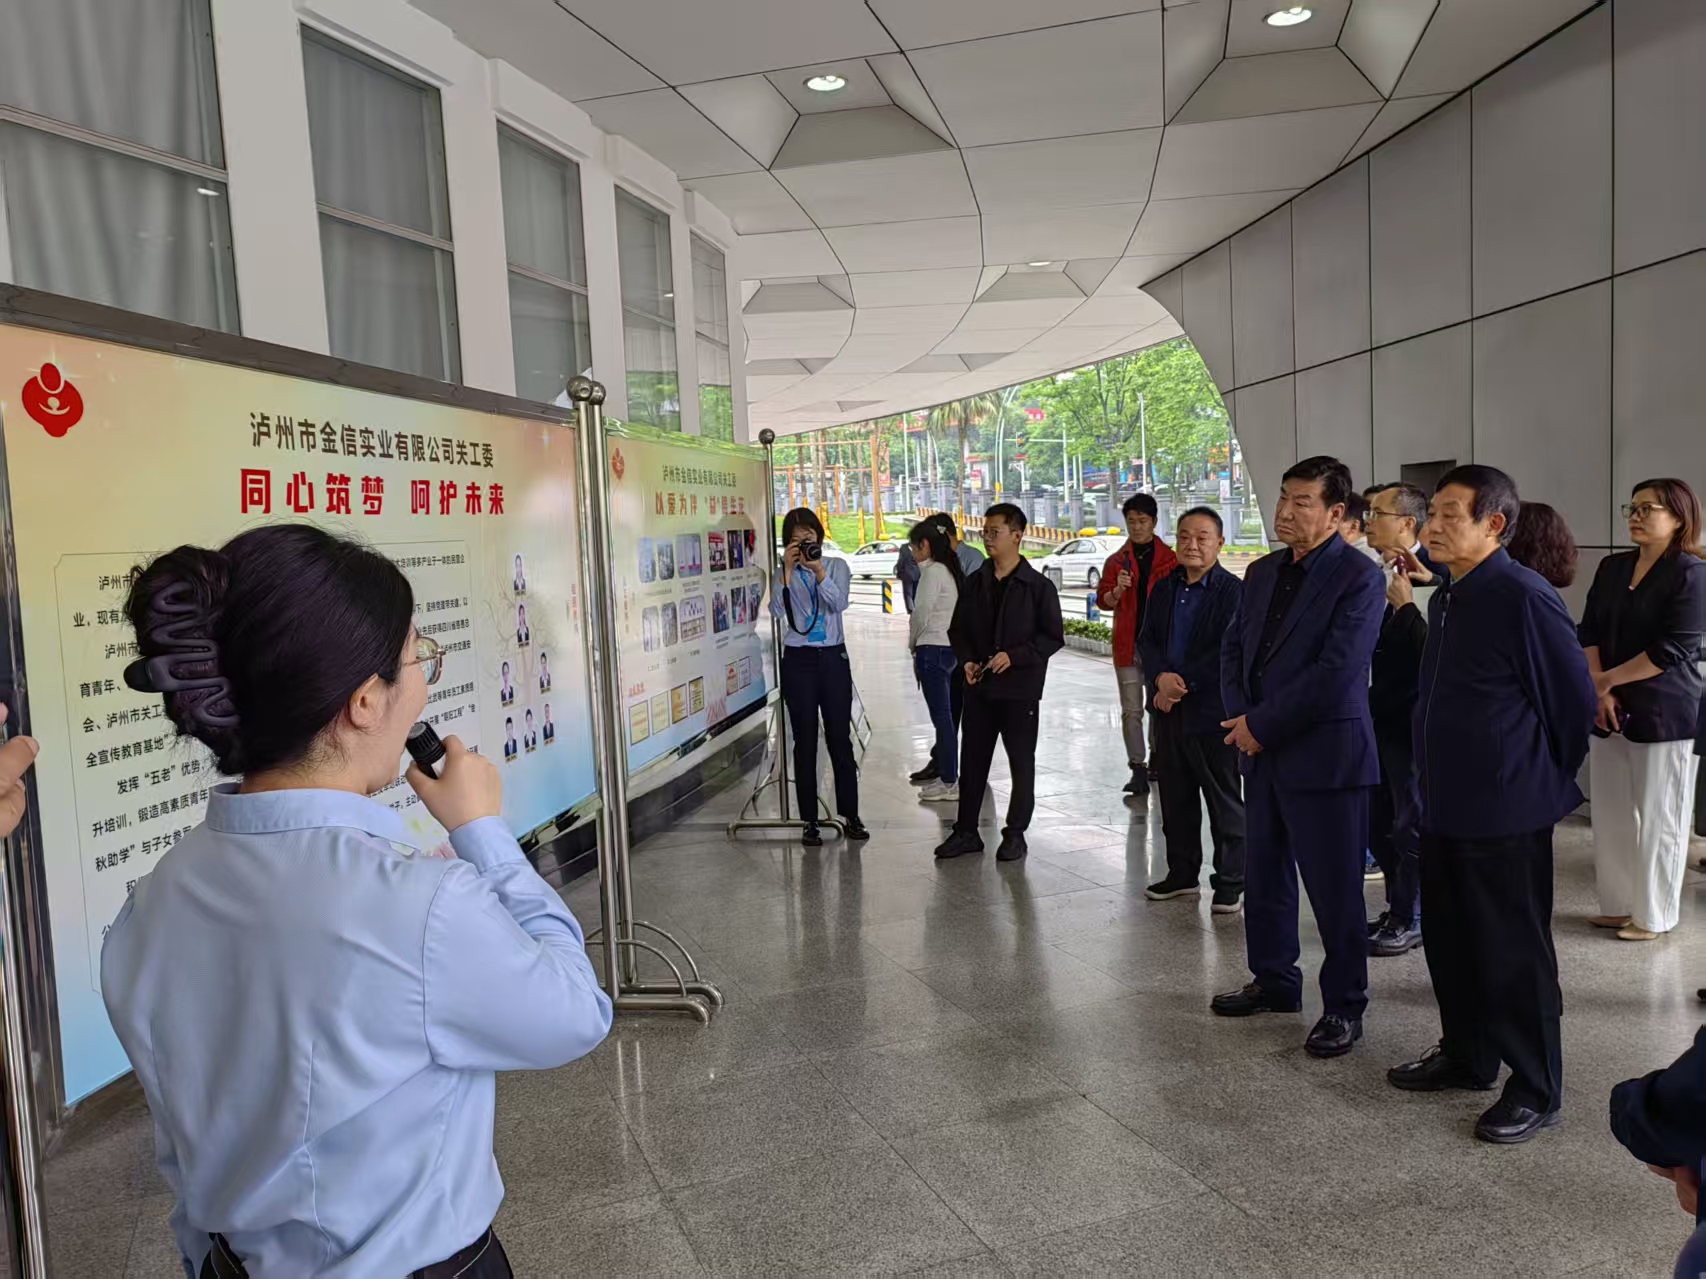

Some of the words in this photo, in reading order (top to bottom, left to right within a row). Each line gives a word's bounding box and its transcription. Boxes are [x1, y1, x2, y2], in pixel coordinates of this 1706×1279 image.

[250, 412, 494, 468] 泸州市金信实业有限公司关工委
[241, 468, 385, 515] 同心筑梦
[411, 479, 504, 515] 呵护未来
